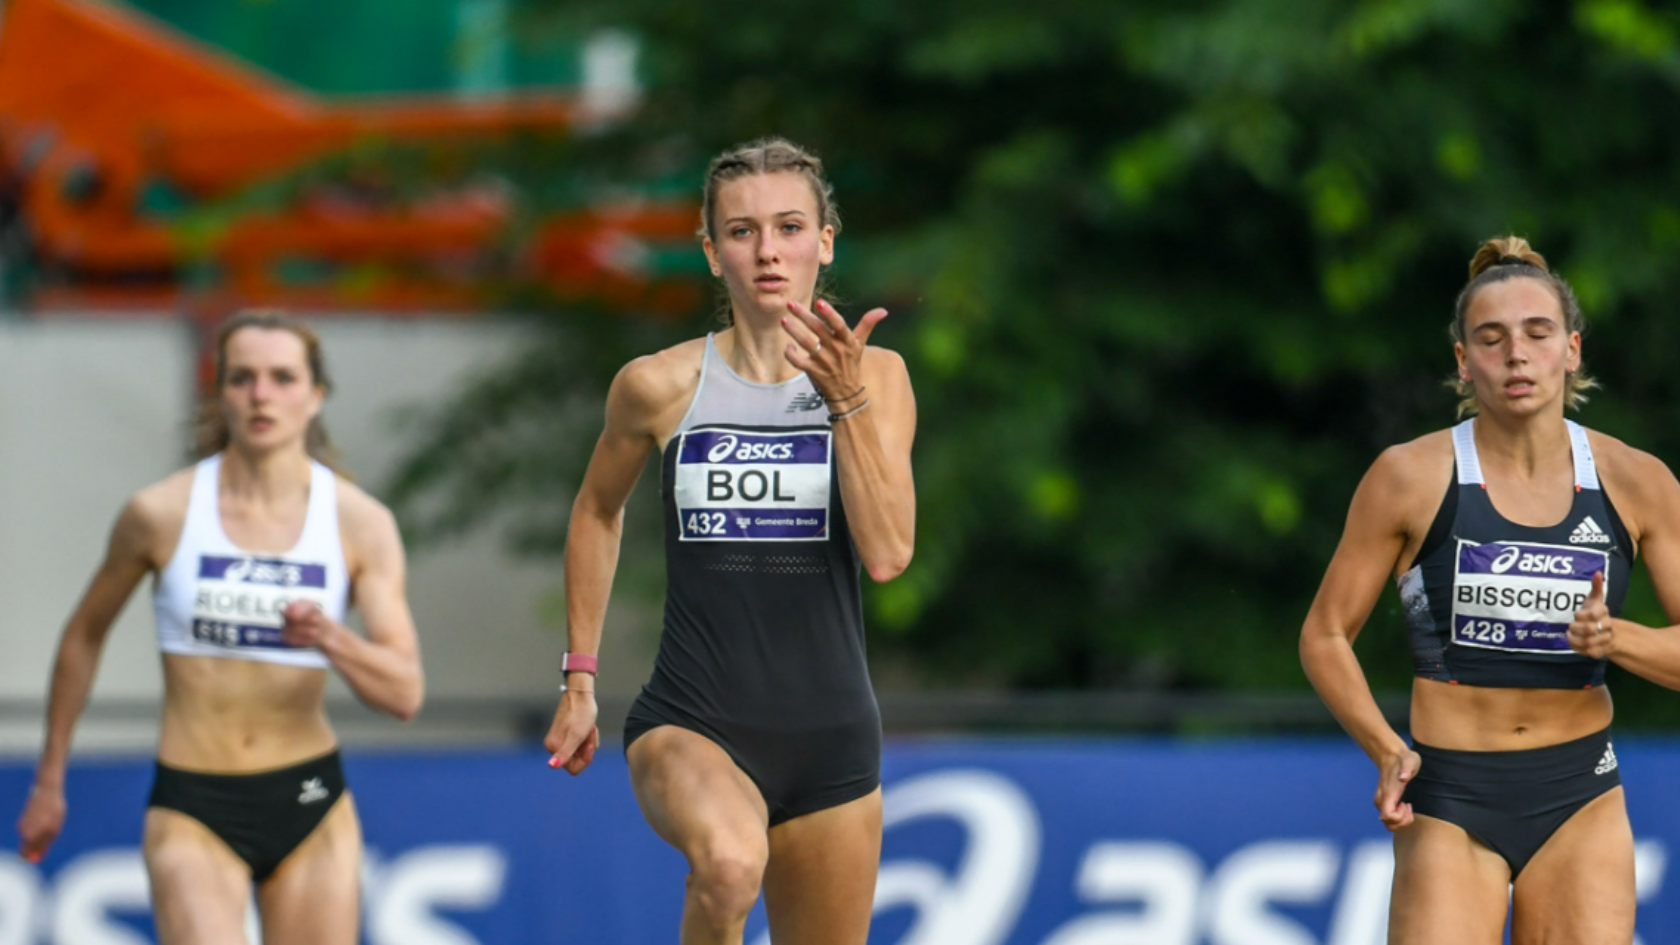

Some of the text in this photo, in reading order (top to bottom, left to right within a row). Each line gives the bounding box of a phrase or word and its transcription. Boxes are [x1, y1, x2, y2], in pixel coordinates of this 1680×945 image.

[736, 443, 792, 460] asics
[707, 470, 795, 502] BOL
[687, 512, 726, 534] 432
[754, 517, 818, 526] Gemeente Breda
[1569, 532, 1610, 544] adidas
[1518, 554, 1573, 574] asics
[1461, 620, 1506, 643] 428
[1531, 629, 1567, 639] Gemeent
